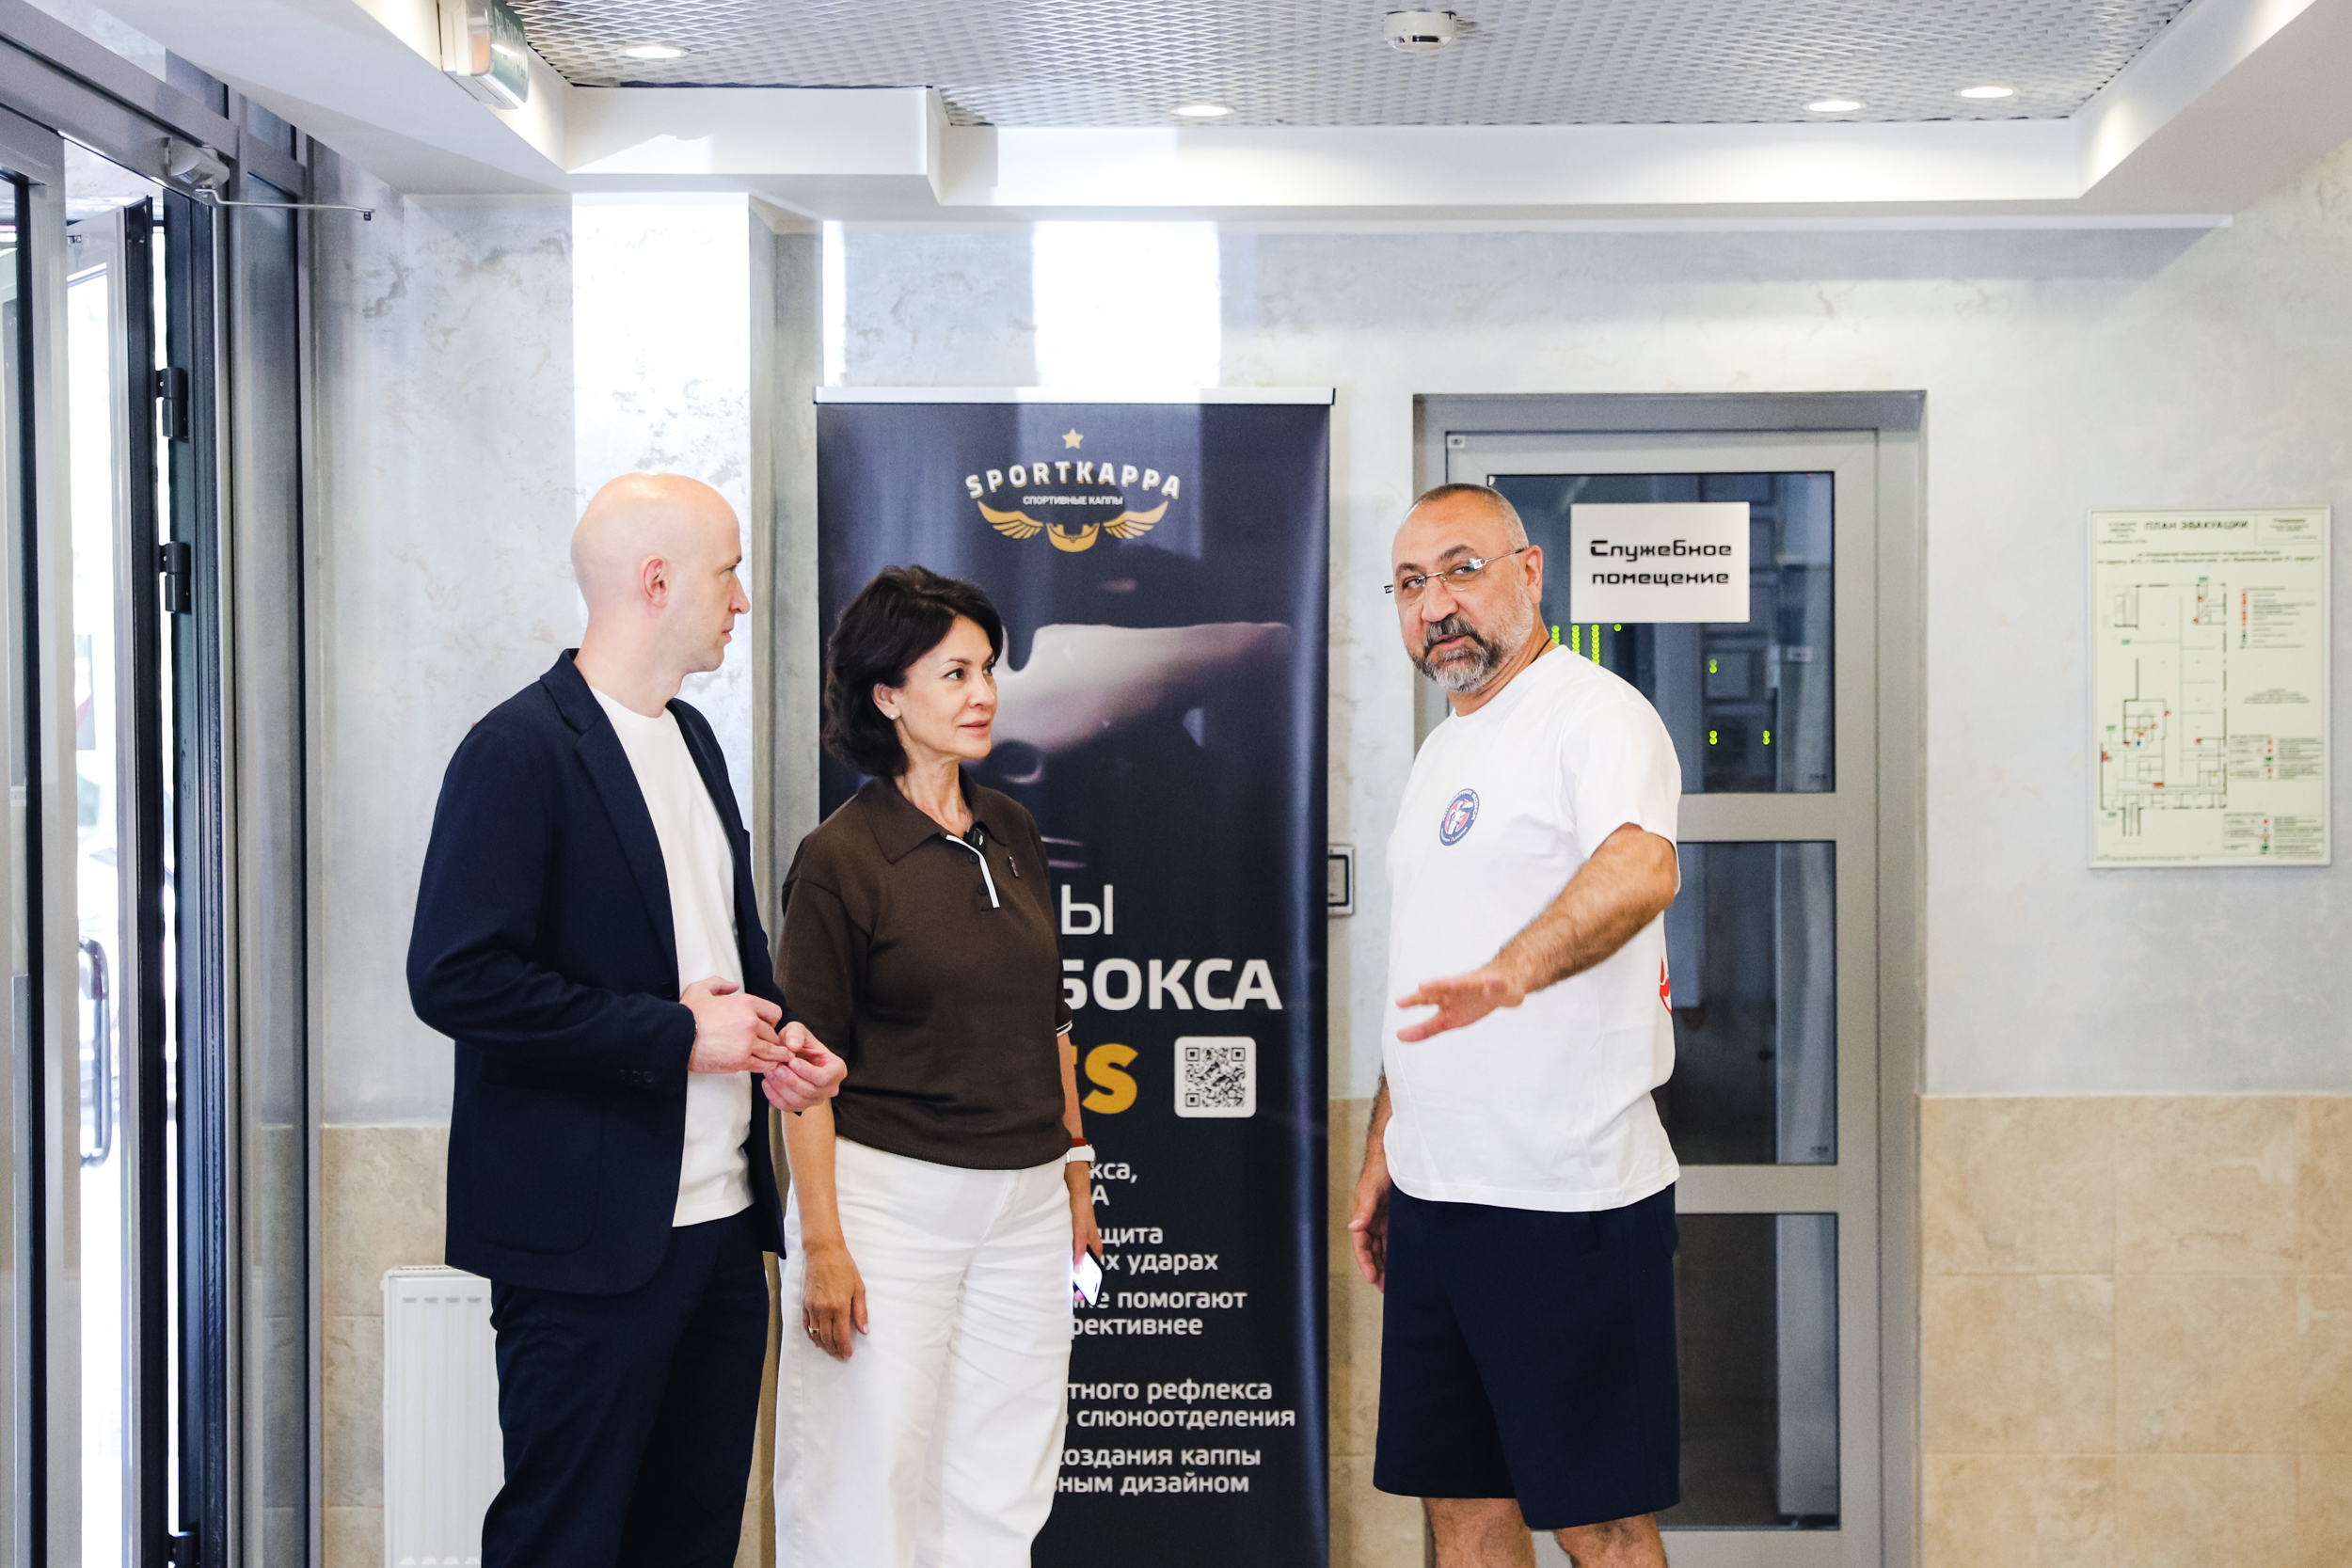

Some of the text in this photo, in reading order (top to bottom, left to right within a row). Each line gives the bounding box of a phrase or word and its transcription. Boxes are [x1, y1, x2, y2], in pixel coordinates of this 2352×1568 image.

[965, 460, 1181, 499] SPORTKAPPA
[1023, 495, 1123, 506] СПОРТИВНЫЕ КАППЫ
[1590, 539, 1732, 562] Служебное
[1592, 572, 1729, 587] помещение
[1061, 884, 1114, 935] Ы
[1089, 1162, 1137, 1183] кса,
[1091, 1184, 1110, 1206] А
[1097, 1227, 1164, 1247] щита
[1127, 1254, 1218, 1275] ударах
[1117, 1291, 1248, 1308] помогают
[1068, 1378, 1272, 1404] тного рефлекса
[1076, 1410, 1295, 1430] слюноотделения
[1181, 1449, 1261, 1465] каппы
[1055, 1471, 1249, 1497] ным дизайном
